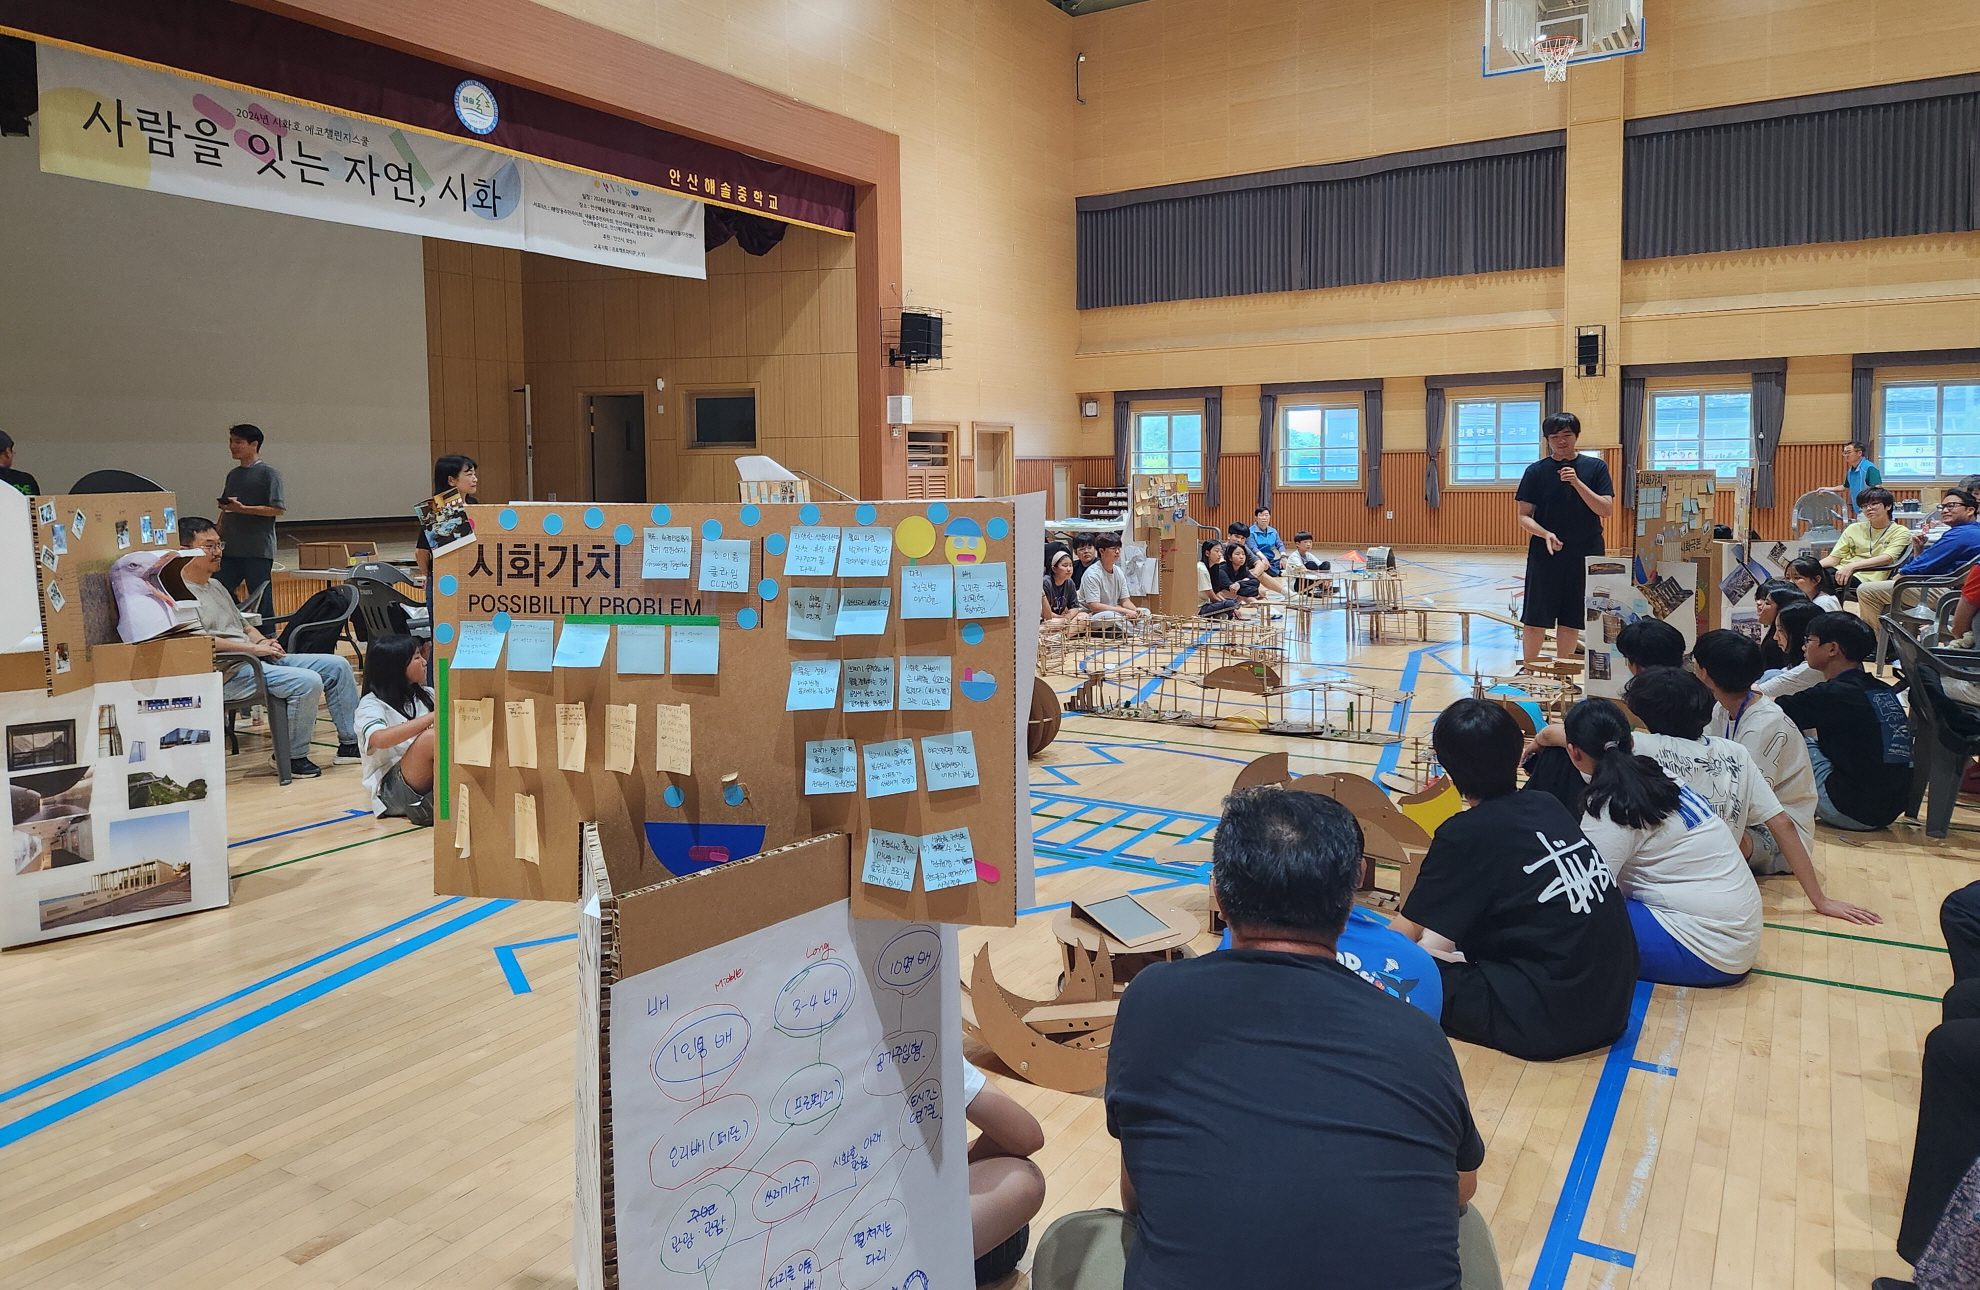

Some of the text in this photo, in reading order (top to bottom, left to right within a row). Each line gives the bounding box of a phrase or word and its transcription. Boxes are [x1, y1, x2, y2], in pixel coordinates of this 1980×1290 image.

[236, 108, 370, 147] 2024년 시화호 에코챌린지스쿨
[82, 98, 502, 218] 사람을 잇는 자연, 시화
[668, 168, 779, 211] 안산해솔중학교
[468, 542, 622, 588] 시화가치
[710, 580, 740, 590] CLIMB
[468, 593, 702, 616] POSSIBILITY PROBLEM
[805, 942, 837, 961] Long
[646, 994, 670, 1017] 배
[792, 988, 838, 1019] 3-4 배
[714, 1028, 733, 1049] 배
